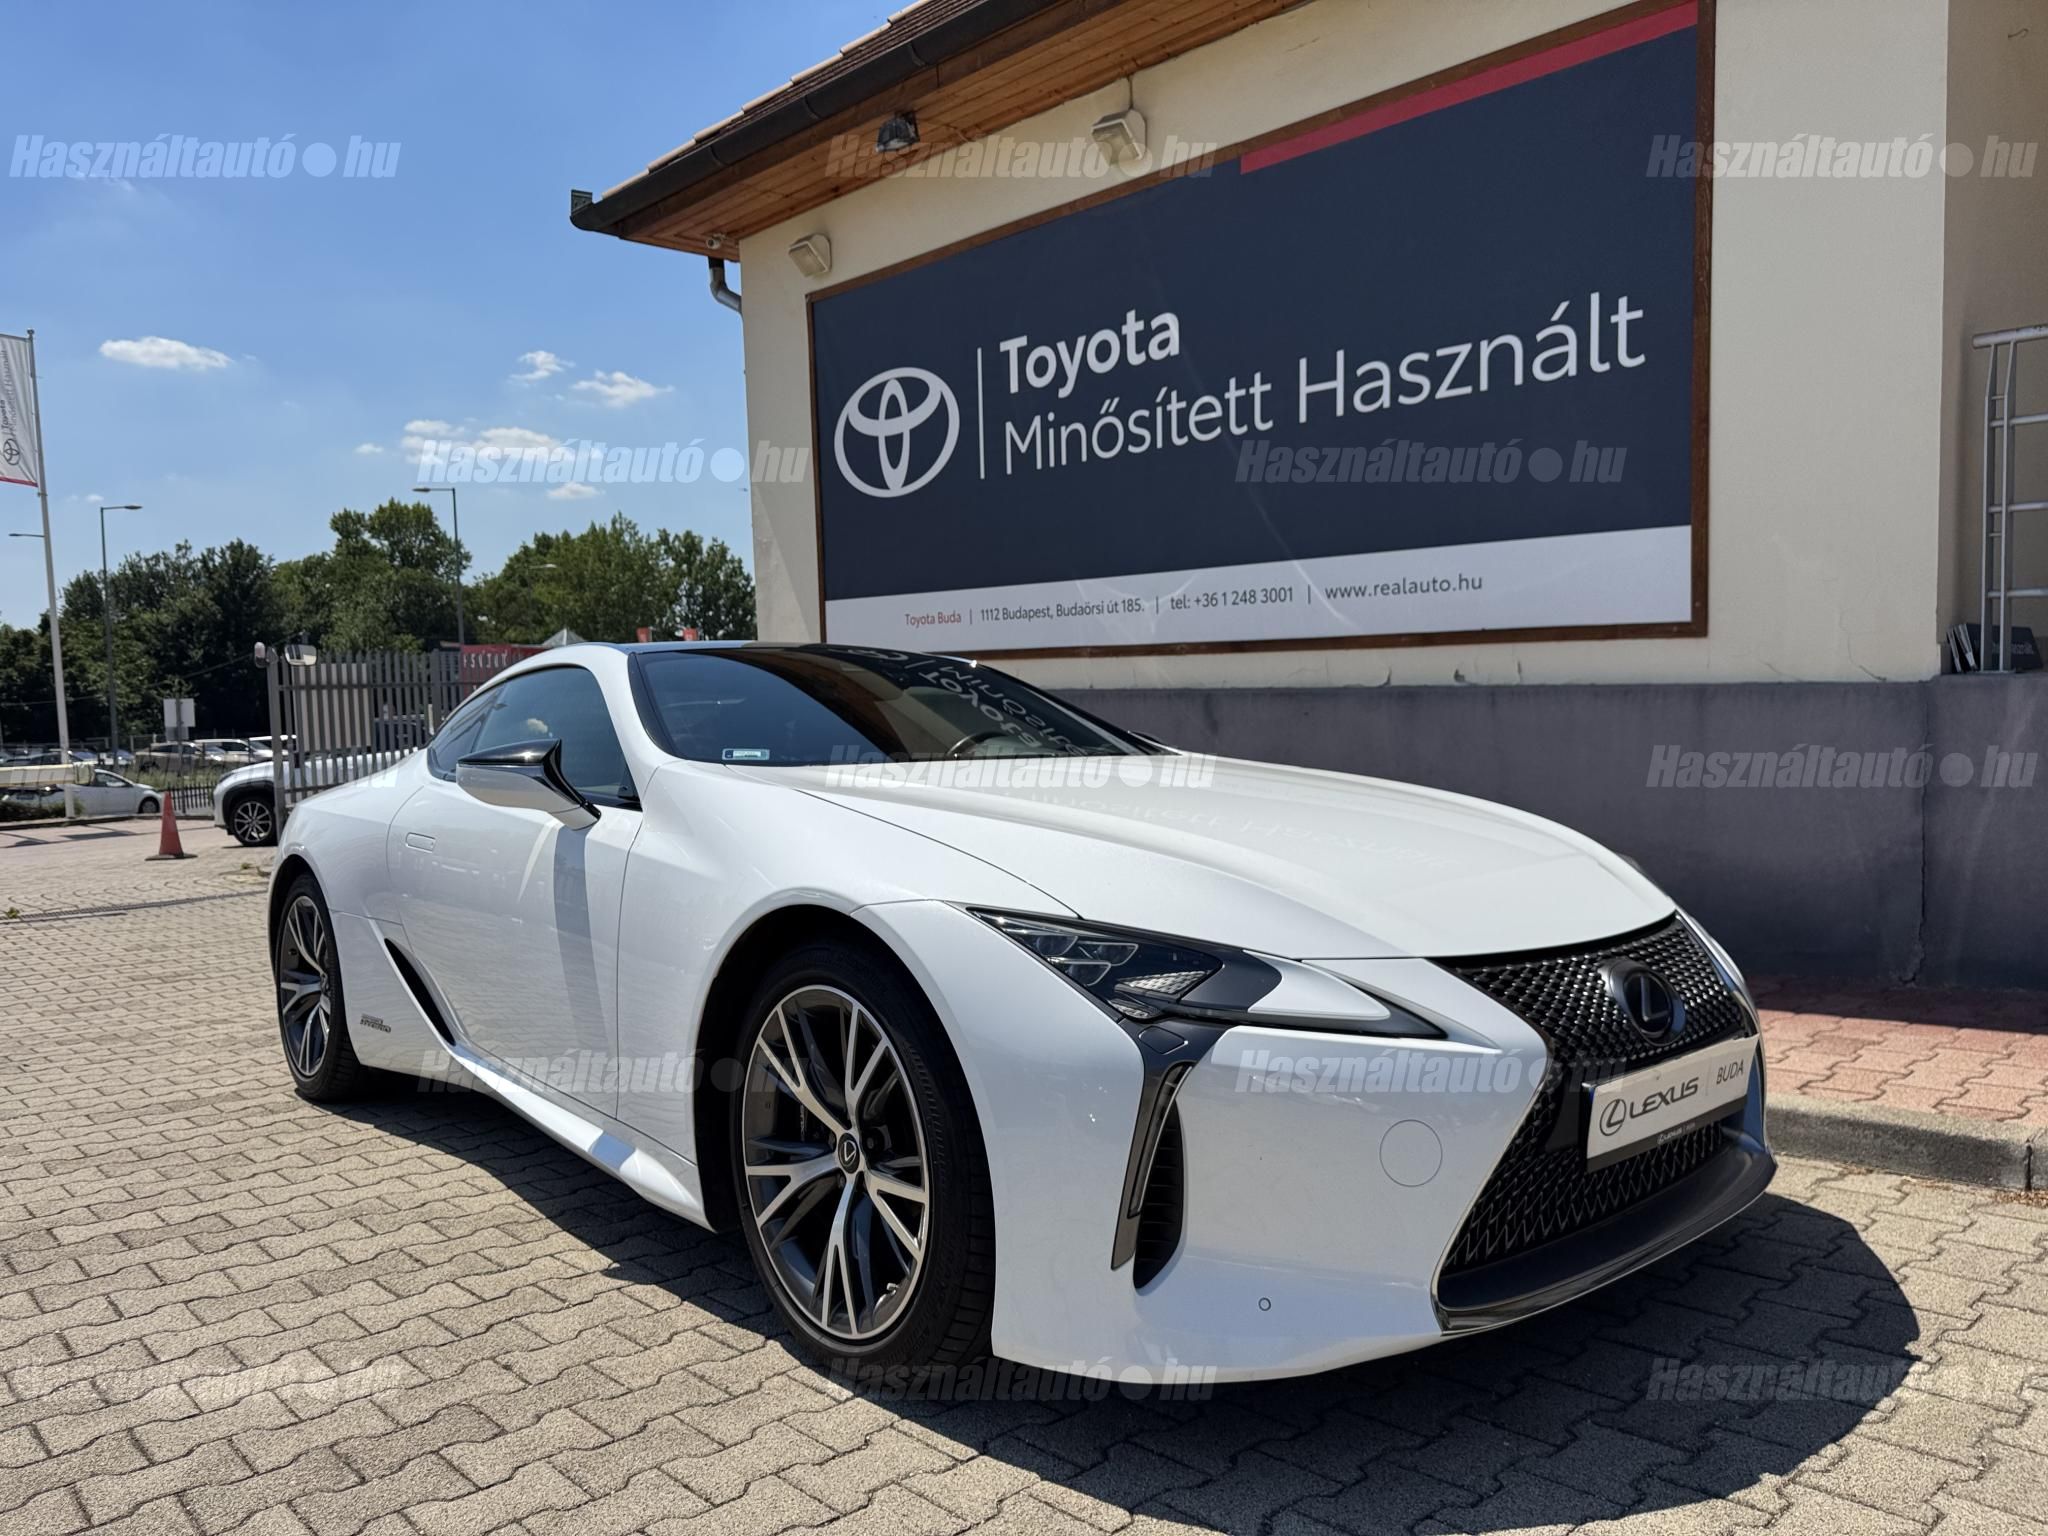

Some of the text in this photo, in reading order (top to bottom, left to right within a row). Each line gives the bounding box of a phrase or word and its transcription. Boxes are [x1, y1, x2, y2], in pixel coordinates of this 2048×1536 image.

[999, 308, 1181, 400] Toyota
[1004, 291, 1646, 476] Minősített Használt
[1170, 594, 1191, 611] tel:
[1194, 591, 1219, 608] +36
[1231, 589, 1257, 606] 248
[1260, 586, 1294, 604] 3001
[1324, 572, 1483, 601] www.realauto.hu
[904, 611, 962, 629] Toyota Buda
[980, 598, 1145, 625] 1112 Budapest, Budaörsi út 185.
[1629, 1076, 1700, 1120] LEXUS
[1716, 1059, 1744, 1085] BUDA
